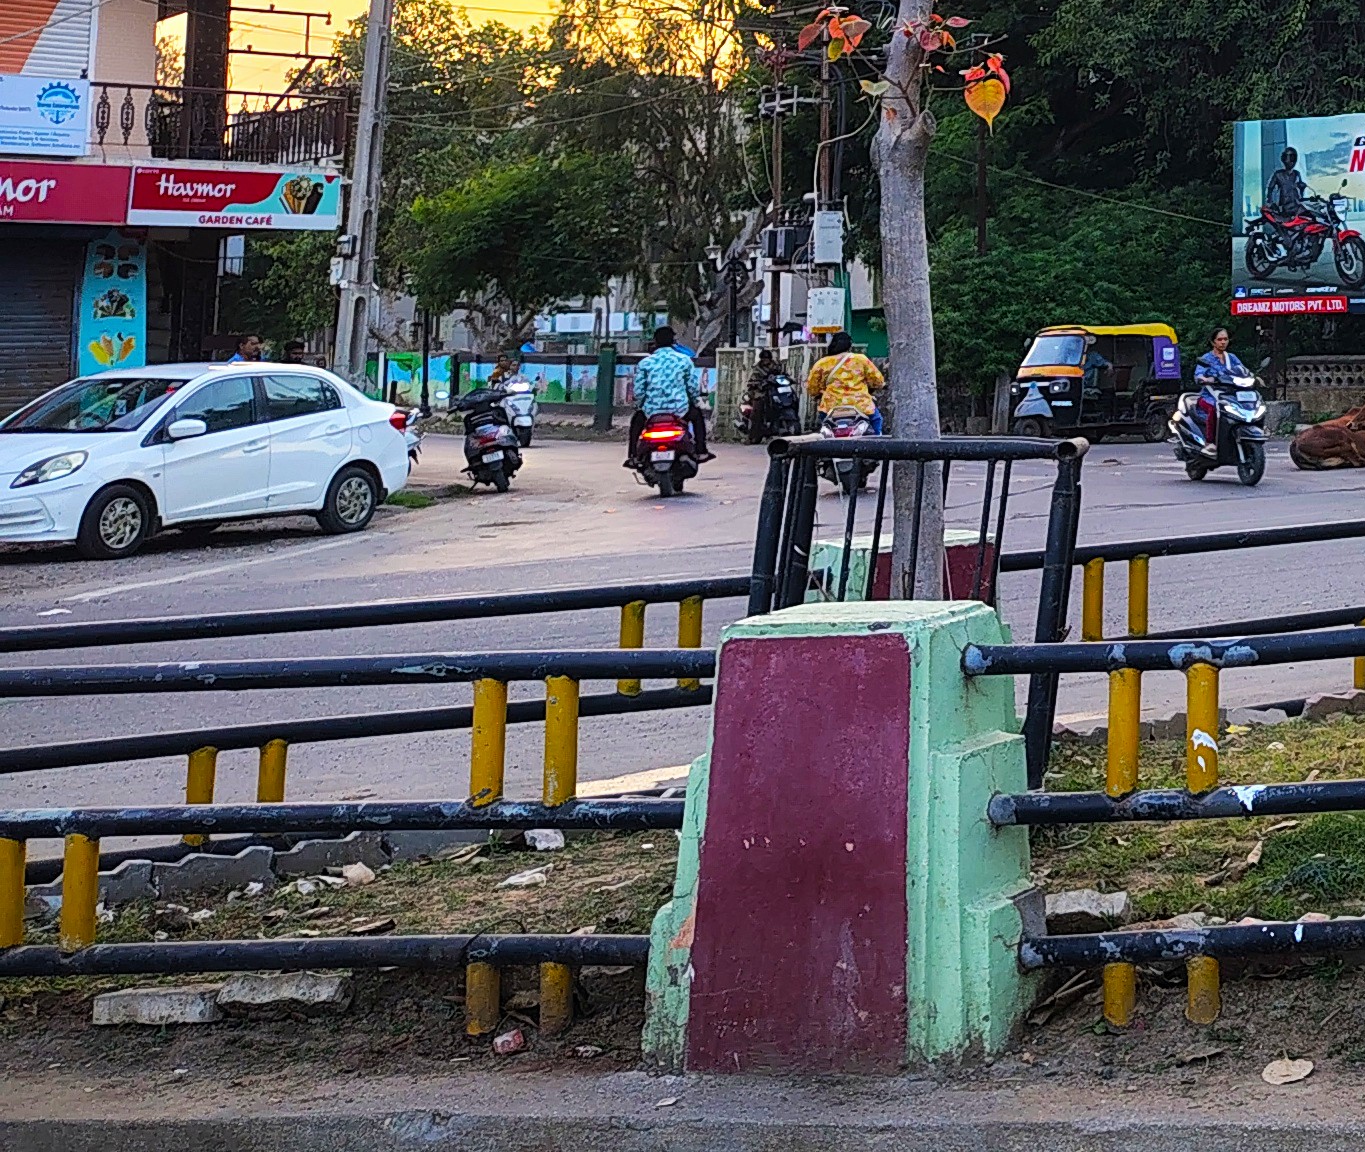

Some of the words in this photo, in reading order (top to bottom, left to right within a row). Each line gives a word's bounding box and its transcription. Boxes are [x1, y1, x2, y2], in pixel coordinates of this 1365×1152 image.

[155, 173, 236, 198] Havmor
[198, 214, 243, 225] GARDEN
[245, 214, 273, 226] CAFÉ
[1236, 300, 1271, 313] DREAMZ
[1271, 300, 1306, 313] MOTORS
[1307, 299, 1326, 312] PVT.
